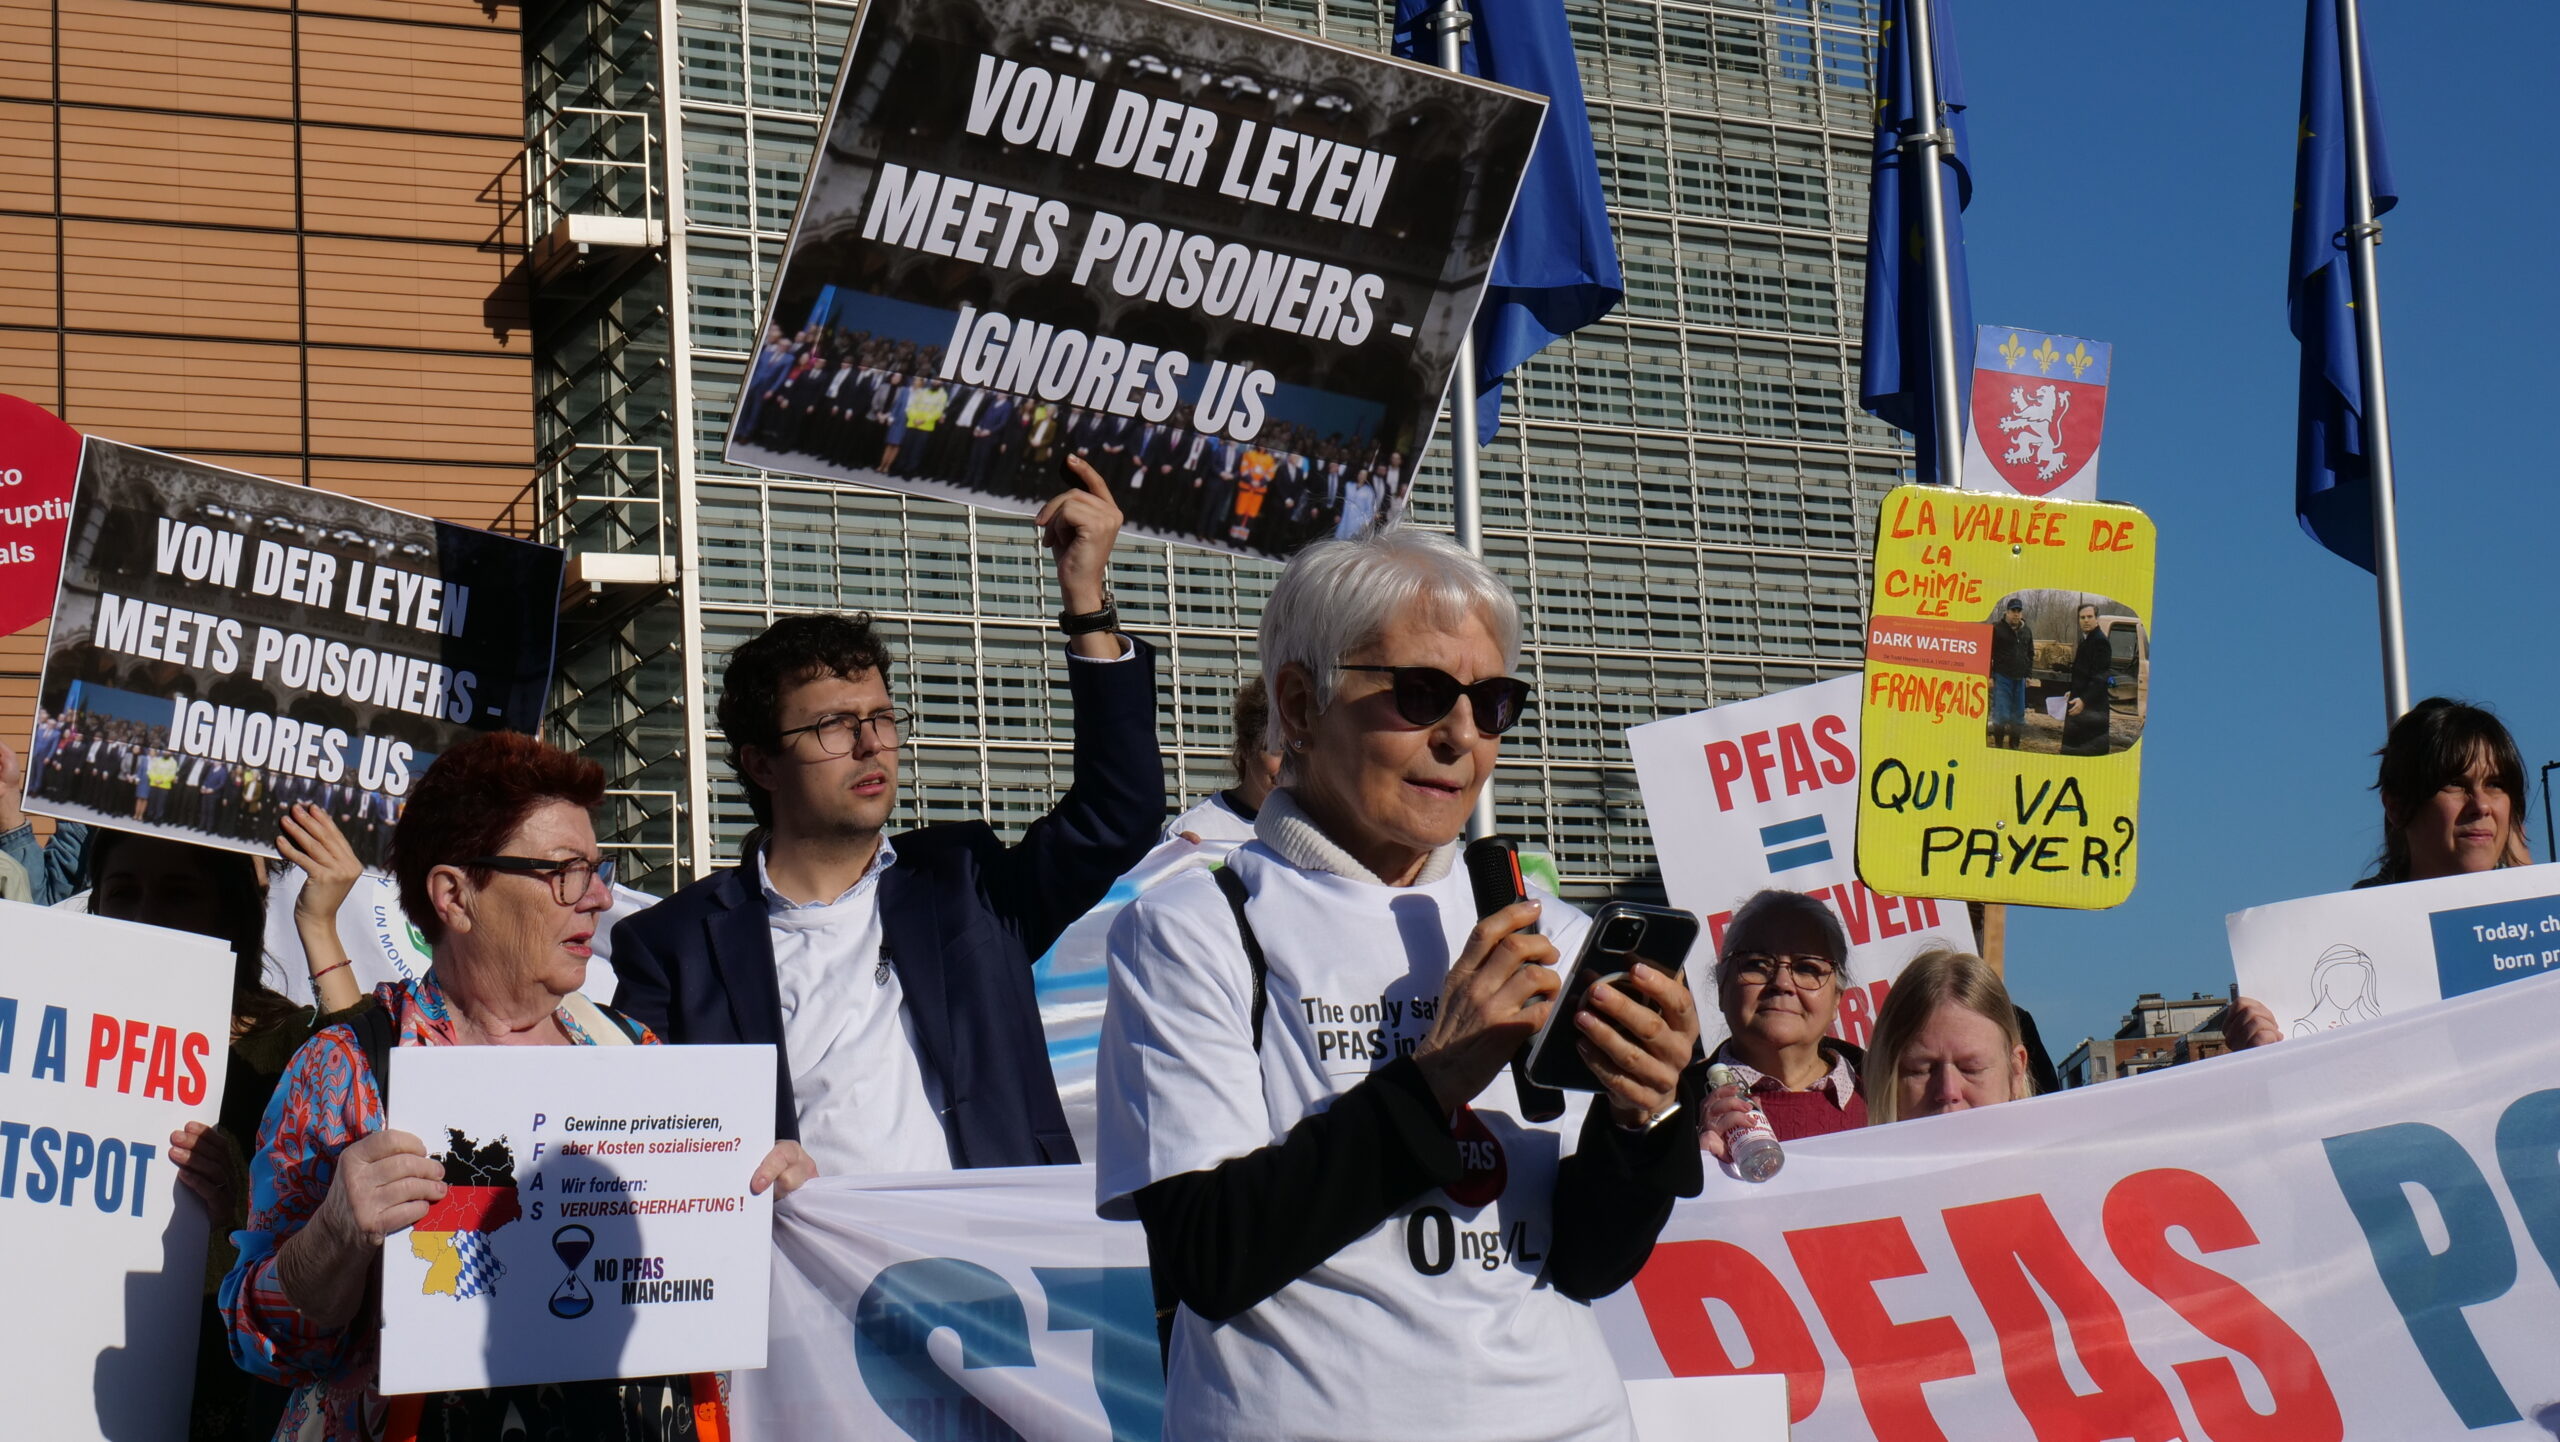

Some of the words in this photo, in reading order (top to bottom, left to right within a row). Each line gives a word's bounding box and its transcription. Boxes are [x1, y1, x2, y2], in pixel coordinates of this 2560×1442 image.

[965, 53, 1095, 158] VON
[1094, 89, 1219, 187] DER
[1219, 119, 1396, 228] LEYEN
[861, 162, 1069, 276] MEETS
[1072, 212, 1385, 347] POISONERS
[940, 306, 1189, 423] IGNORES
[1194, 361, 1276, 442] US
[1891, 496, 1936, 540] LA
[1953, 502, 2066, 548] VALLÉE
[2089, 519, 2134, 552] DE
[1921, 544, 1951, 566] LA
[156, 517, 244, 588] VON
[252, 541, 336, 609] DER
[345, 560, 469, 638] LEYEN
[1916, 598, 1949, 617] LE
[94, 593, 242, 675] MEETS
[252, 626, 477, 725] POISONERS
[1872, 630, 1913, 648] DARK
[1916, 635, 1978, 655] WATERS
[168, 696, 348, 783] IGNORES
[358, 735, 413, 796] US
[1704, 715, 1856, 812] PFAS
[2014, 774, 2089, 828] VA
[1921, 816, 2134, 879] PAYER?
[374, 905, 388, 927] UN
[2472, 921, 2535, 943] Today,
[2493, 953, 2536, 970] born
[1301, 997, 1344, 1026] The
[1350, 995, 1403, 1028] only
[32, 1004, 67, 1083] A
[85, 1013, 210, 1106] PFAS
[1317, 1029, 1386, 1061] PFAS
[564, 1115, 627, 1133] Gewinne
[630, 1114, 723, 1137] privatisieren,
[561, 1140, 594, 1157] aber
[597, 1139, 645, 1156] Kosten
[648, 1137, 741, 1155] sozialisieren?
[561, 1178, 587, 1194] Wir
[589, 1176, 648, 1194] fordern:
[560, 1198, 735, 1219] VERURSACHERHAFTUNG
[1461, 1220, 1541, 1271] ng/L
[594, 1258, 618, 1282] NO
[622, 1256, 664, 1281] PFAS
[621, 1278, 714, 1306] MANCHING
[1632, 1167, 2344, 1442] PFAS
